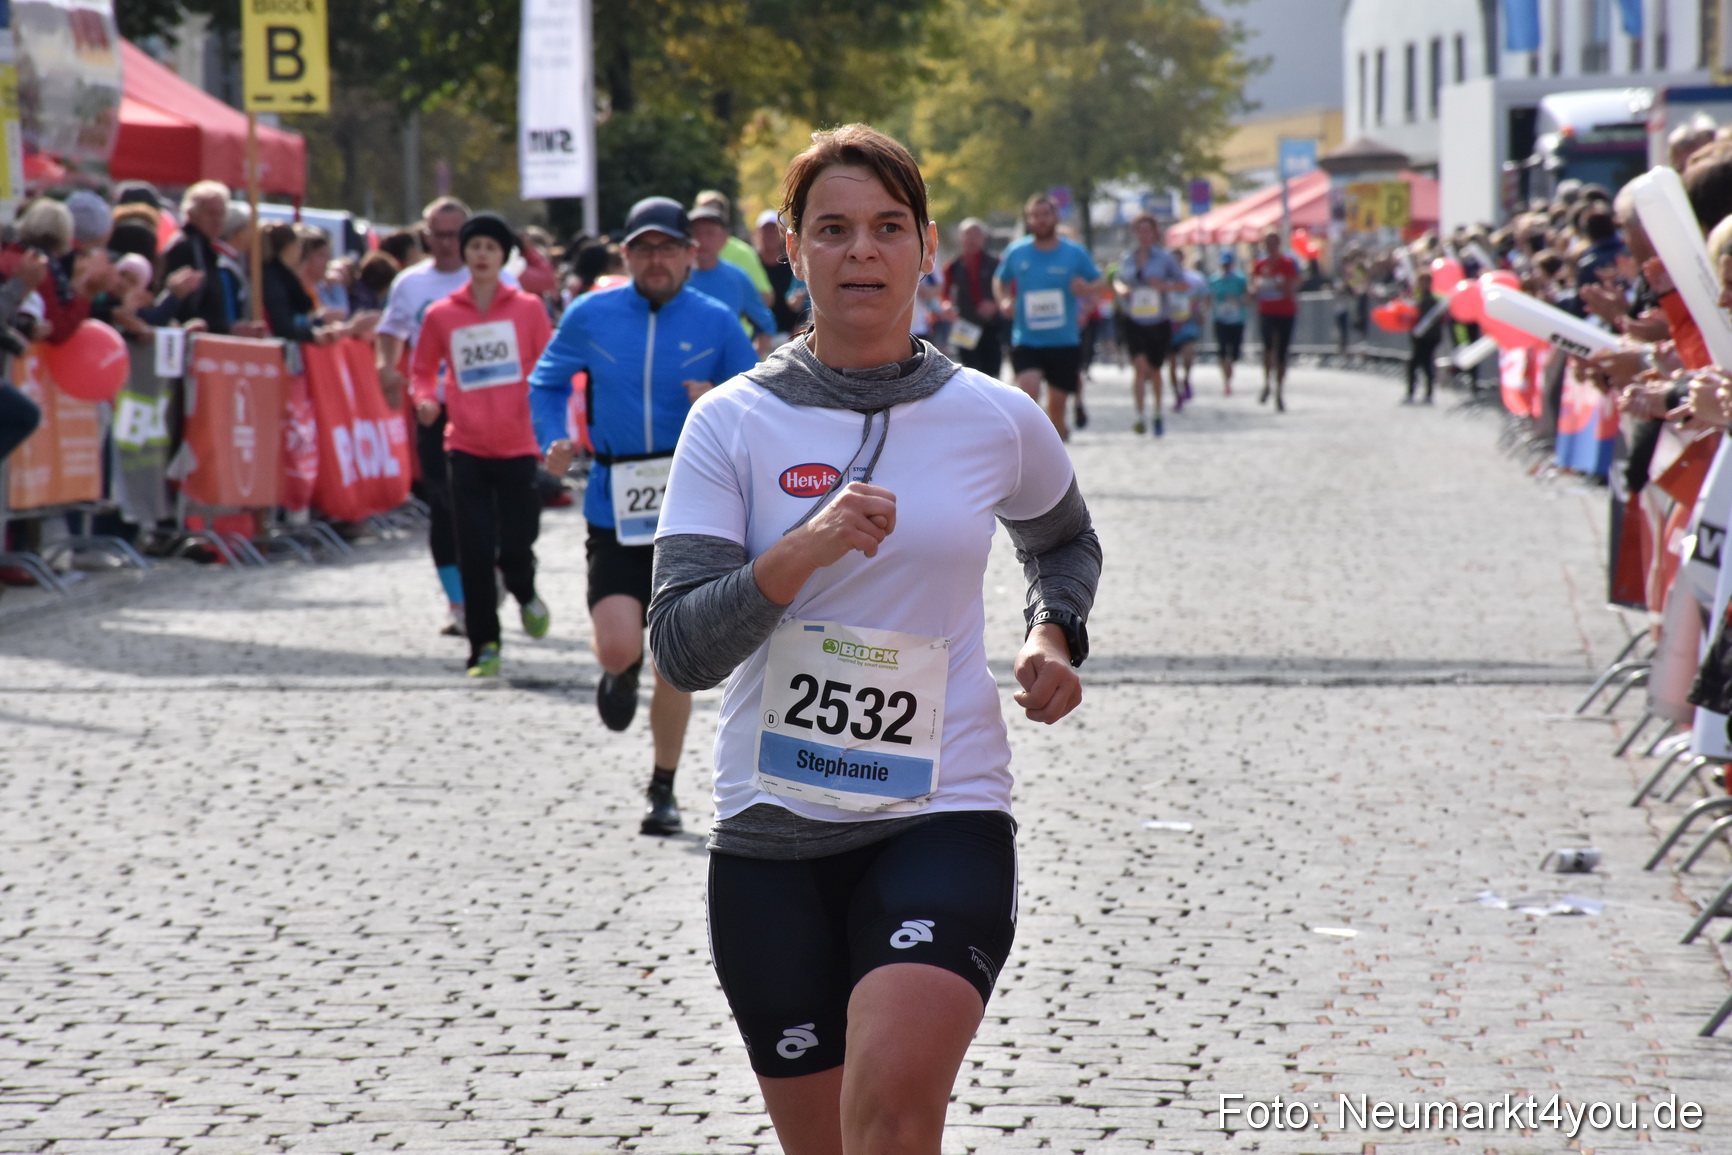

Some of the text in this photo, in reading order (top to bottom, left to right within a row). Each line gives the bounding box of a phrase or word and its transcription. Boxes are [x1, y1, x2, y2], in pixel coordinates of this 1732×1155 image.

[267, 26, 305, 81] B
[460, 341, 509, 366] 2450
[786, 471, 837, 490] Hervis
[837, 656, 857, 666] inspired
[857, 660, 864, 668] by
[839, 641, 900, 665] BOCK
[768, 714, 775, 724] D
[784, 673, 917, 745] 2532
[796, 749, 889, 782] Stephanie
